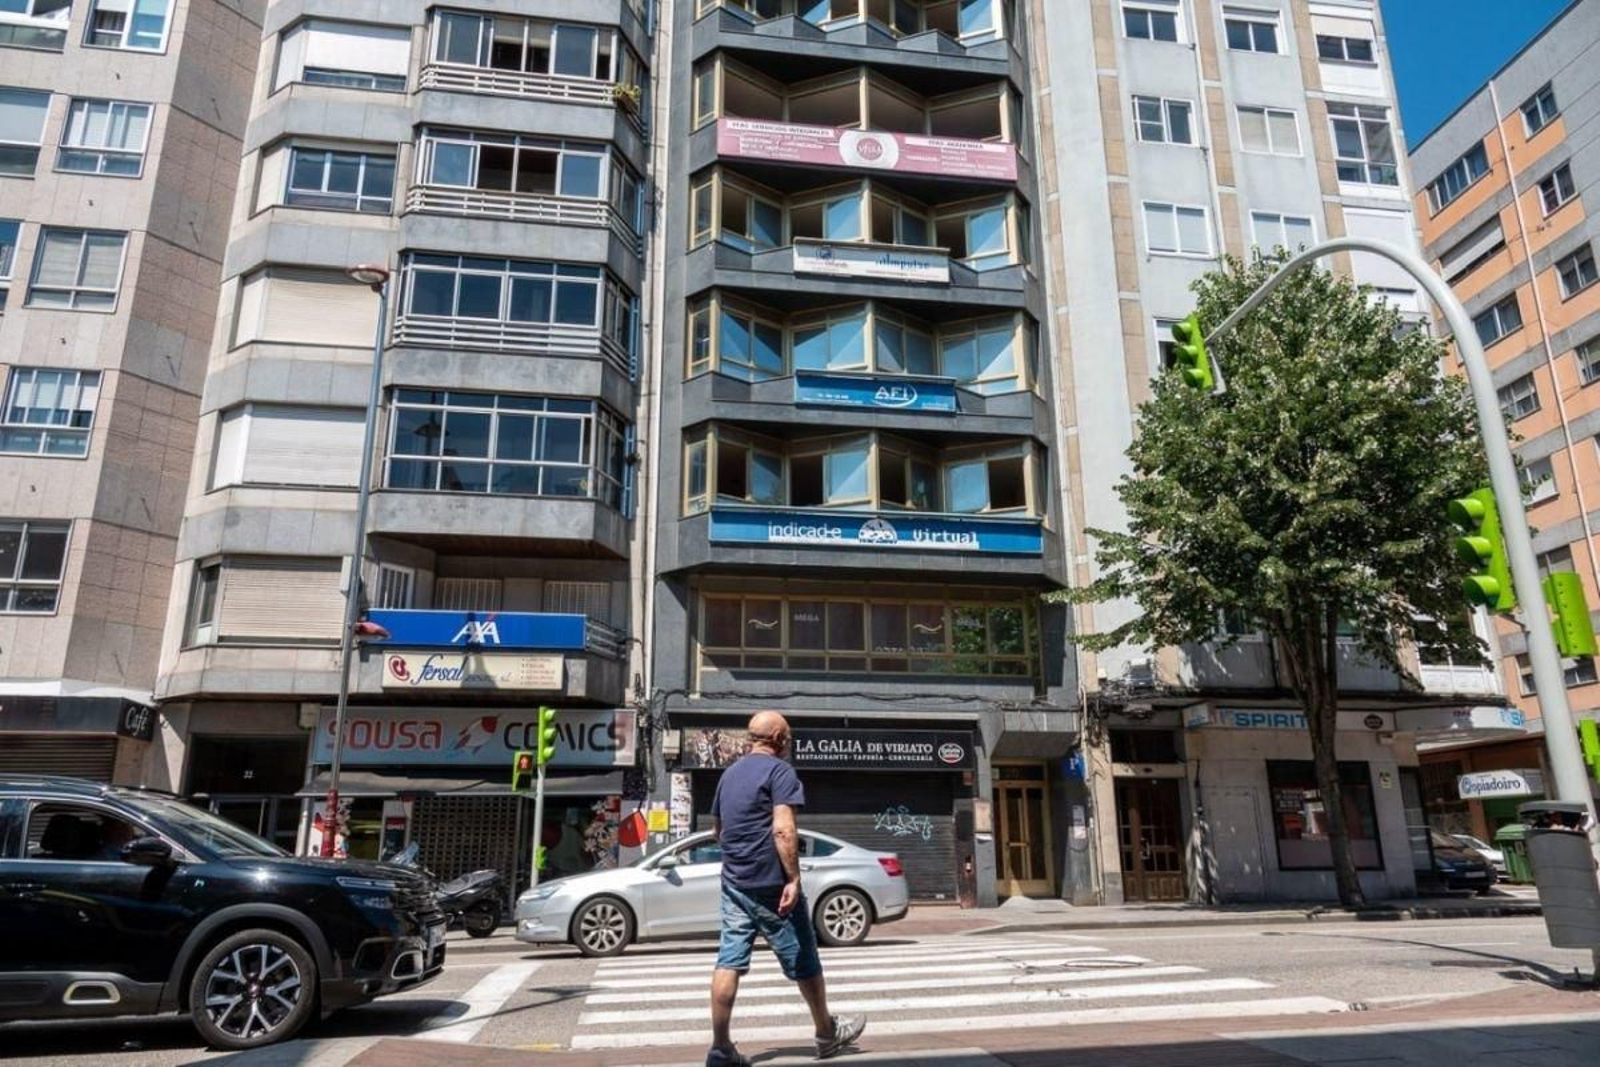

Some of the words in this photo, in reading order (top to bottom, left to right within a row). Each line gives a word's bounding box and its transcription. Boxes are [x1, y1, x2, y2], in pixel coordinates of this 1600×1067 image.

[912, 528, 978, 544] Virtual
[451, 620, 501, 644] AXA
[410, 653, 468, 686] fersal
[126, 706, 149, 736] Café
[503, 722, 627, 752] COMICS
[795, 739, 817, 753] LA
[818, 739, 863, 753] GALIA
[867, 742, 884, 753] DE
[885, 743, 934, 754] VIRIATO
[1461, 775, 1521, 795] Copiadoiro
